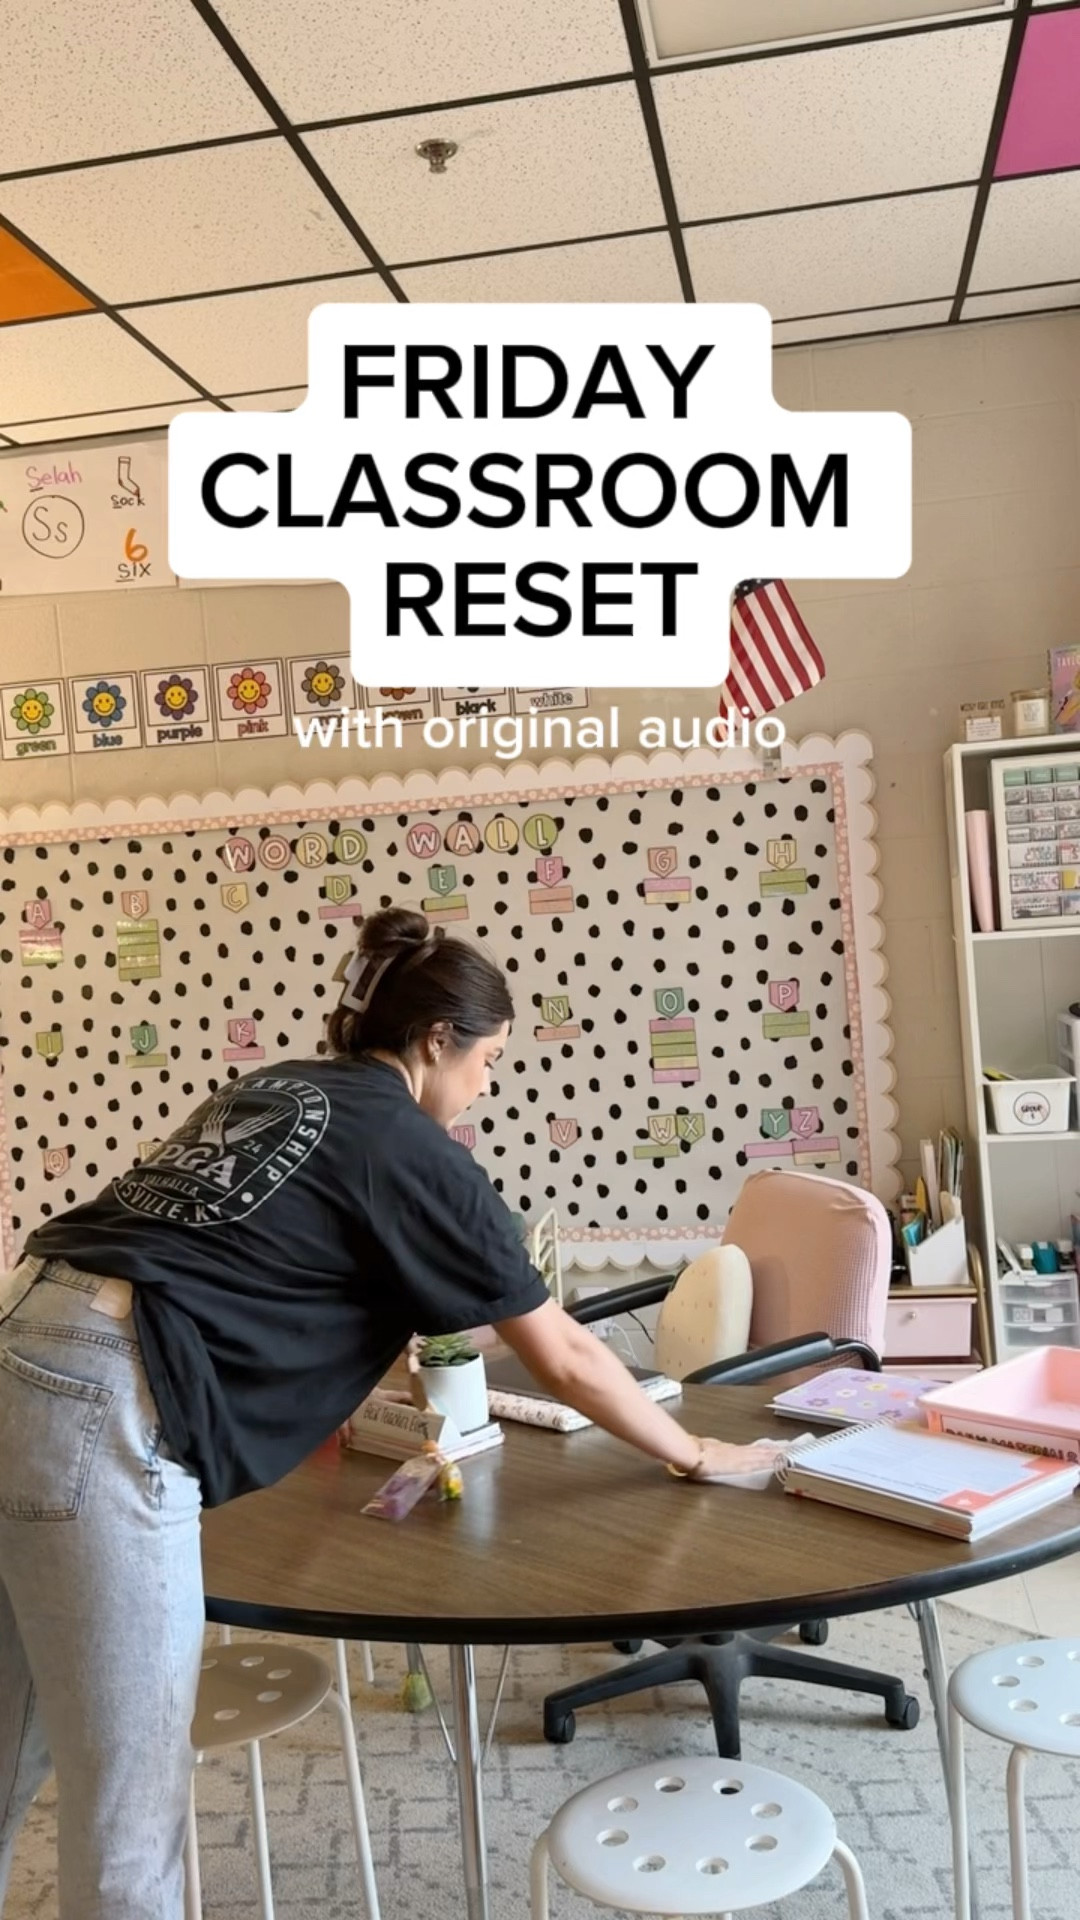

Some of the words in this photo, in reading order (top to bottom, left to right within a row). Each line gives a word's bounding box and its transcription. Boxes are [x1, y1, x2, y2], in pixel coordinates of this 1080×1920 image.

[26, 461, 82, 488] Selah
[125, 528, 148, 562] 6
[530, 691, 573, 707] white
[156, 725, 203, 743] purple
[237, 719, 269, 736] pink
[16, 739, 57, 755] green
[93, 733, 123, 748] blue
[225, 834, 362, 870] WORD
[410, 817, 552, 853] WALL
[243, 1139, 260, 1154] 24
[147, 1143, 238, 1189] PGA
[144, 1174, 200, 1197] VALHALLA
